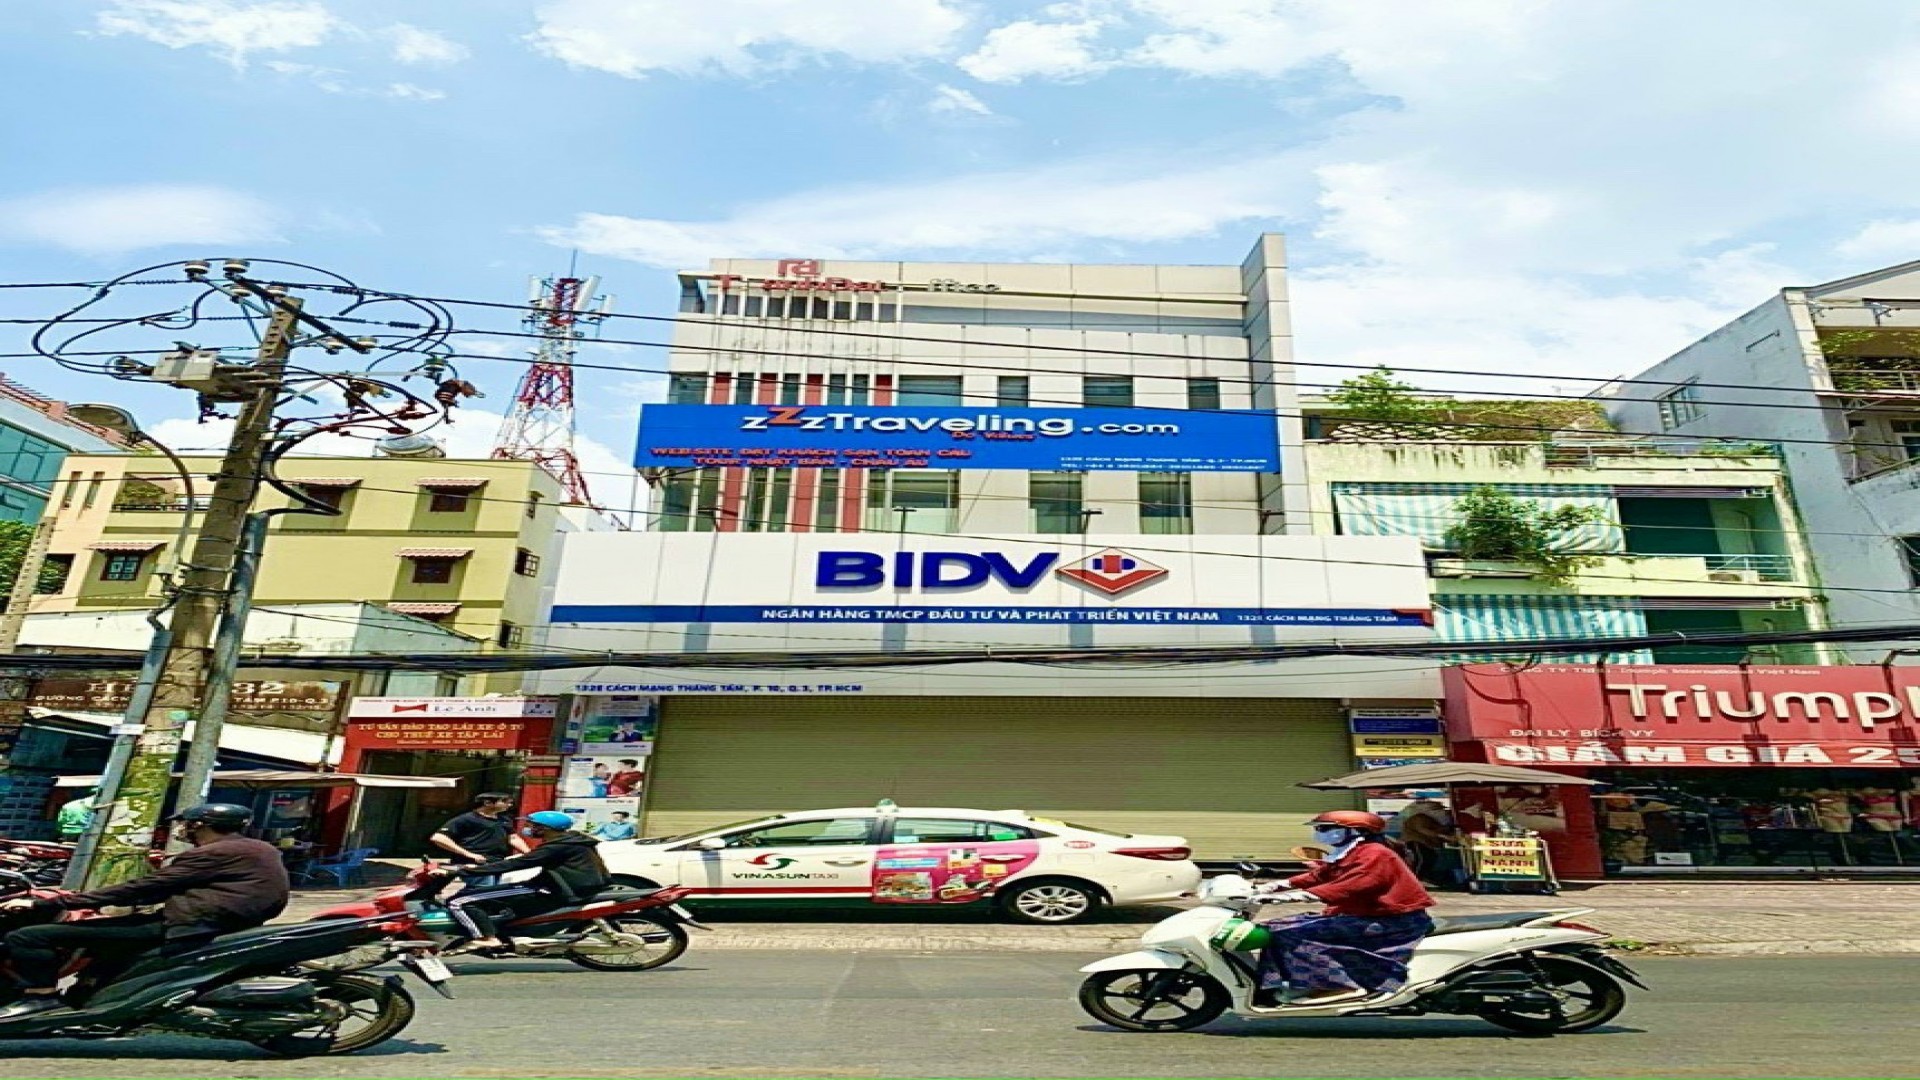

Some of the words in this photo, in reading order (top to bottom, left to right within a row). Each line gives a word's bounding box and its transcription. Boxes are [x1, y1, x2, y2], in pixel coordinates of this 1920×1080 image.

[815, 551, 1060, 590] BIDV
[762, 609, 815, 619] NGÂN
[819, 609, 871, 619] HÀNG
[875, 610, 925, 619] TMCP
[998, 609, 1022, 620] VÀ
[1026, 610, 1073, 620] PHÁT
[1076, 609, 1130, 621] TRIỂN
[1132, 610, 1173, 622] VIỆT
[1177, 611, 1219, 621] NAM
[1629, 729, 1656, 738] VY
[1705, 743, 1829, 764] GIÁ
